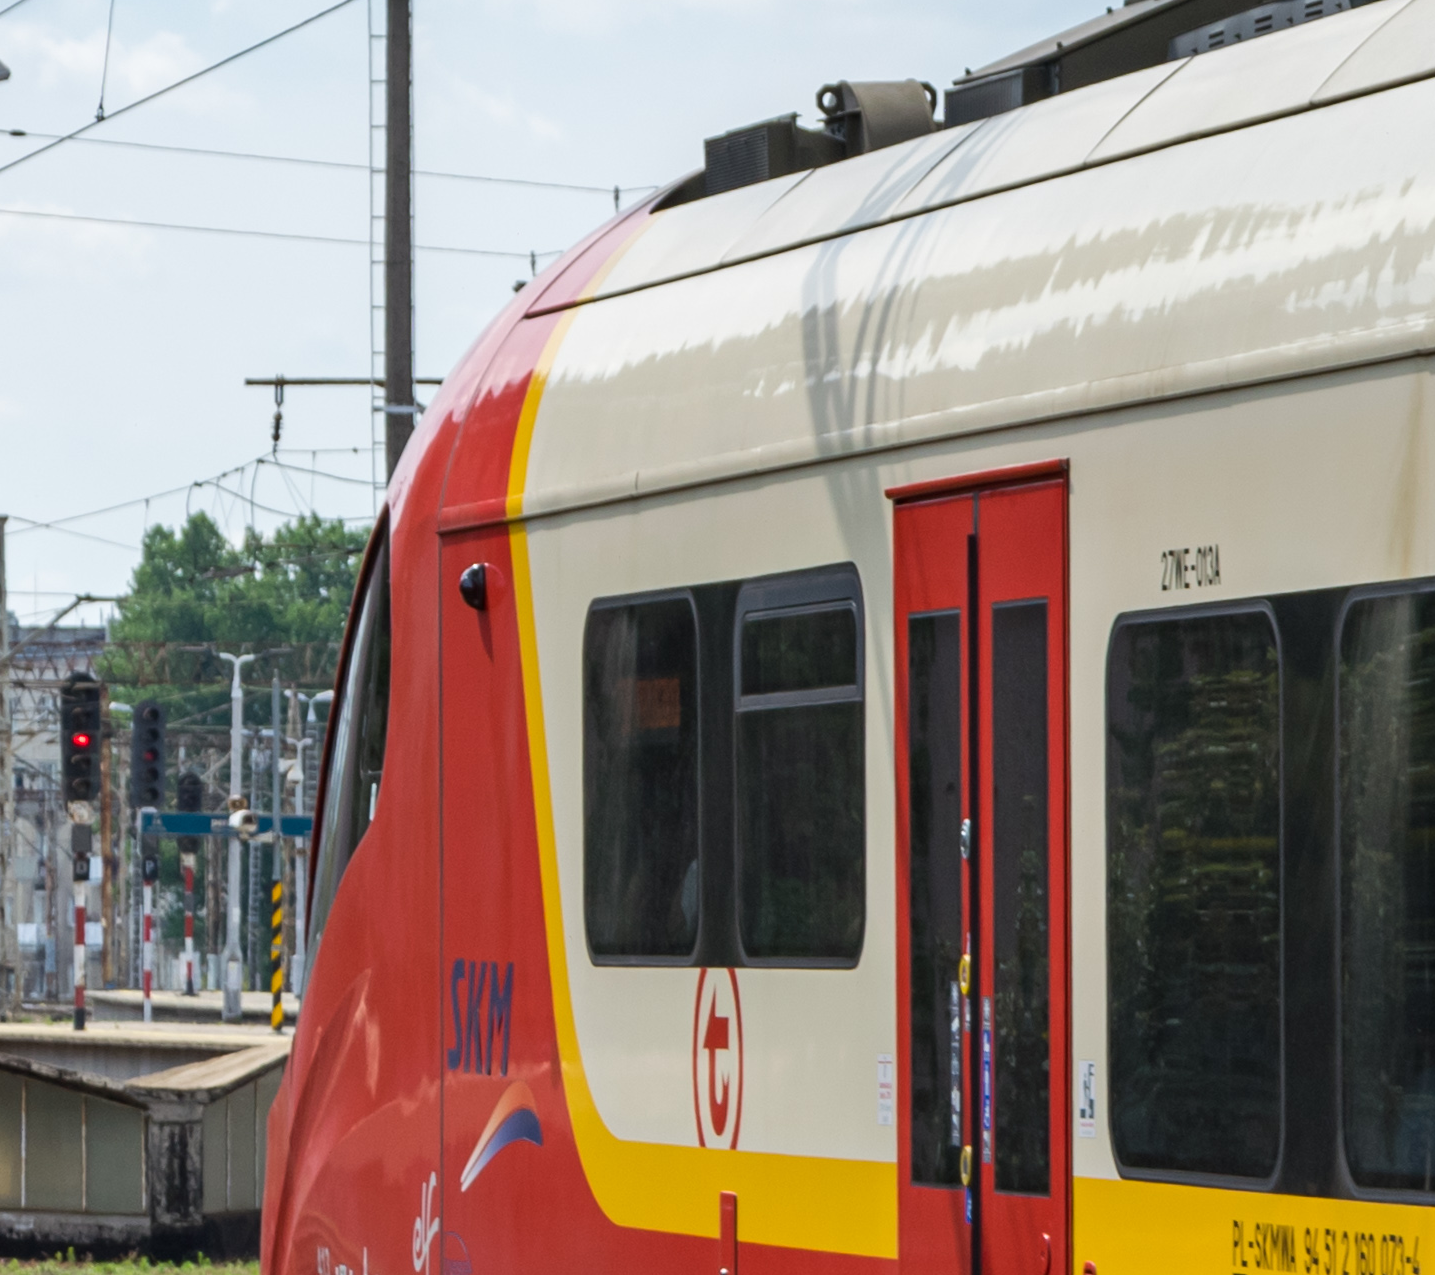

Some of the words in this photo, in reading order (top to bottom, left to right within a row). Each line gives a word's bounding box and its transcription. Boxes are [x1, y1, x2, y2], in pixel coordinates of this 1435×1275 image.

[1160, 543, 1221, 591] 27WE-013A
[447, 958, 514, 1077] SKM
[1304, 1226, 1319, 1275] 94
